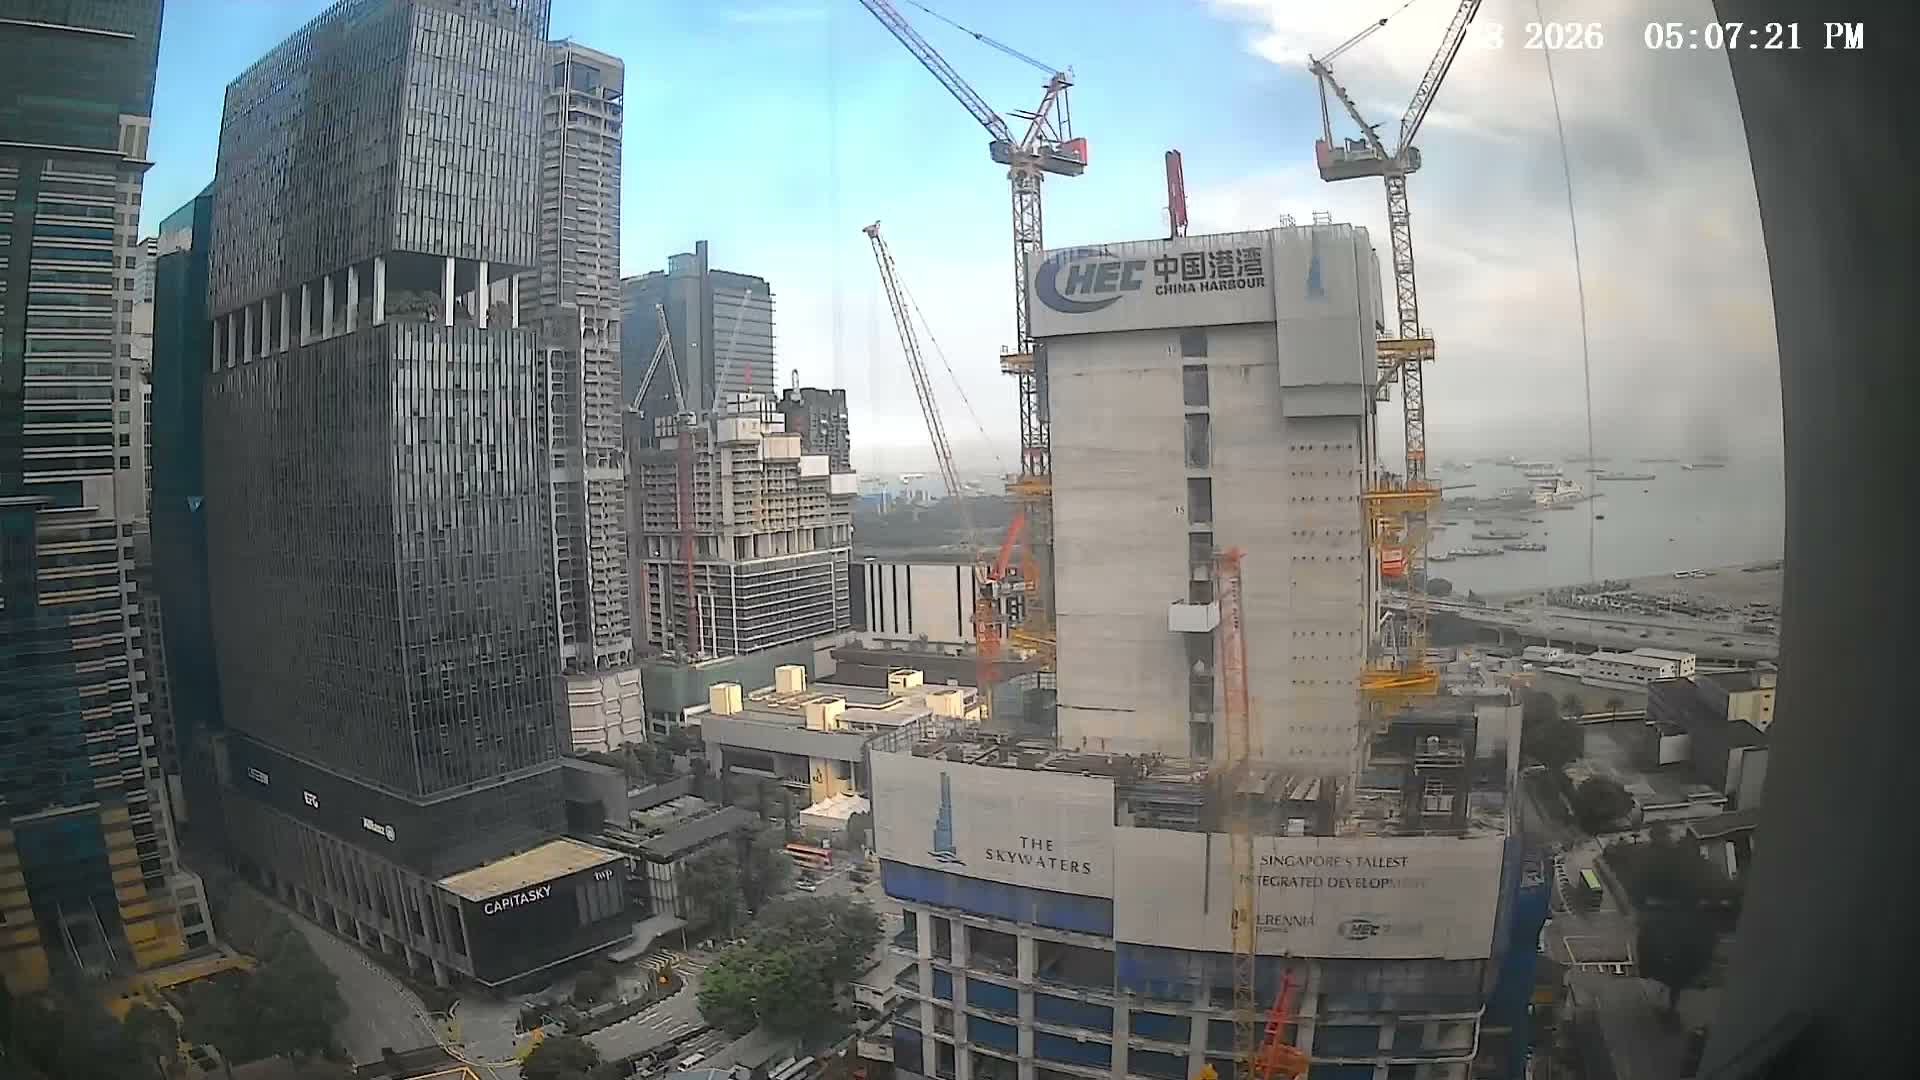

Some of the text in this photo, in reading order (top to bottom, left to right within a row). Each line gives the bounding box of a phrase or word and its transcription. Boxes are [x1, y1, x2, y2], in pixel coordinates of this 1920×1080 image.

[1153, 247, 1263, 284] 中国港湾
[1154, 276, 1266, 297] CHINA HARBOUR
[1019, 835, 1054, 852] THE
[985, 847, 1092, 875] SKYWATERS
[1355, 855, 1409, 868] TALLEST
[483, 883, 553, 915] CAPITASKY
